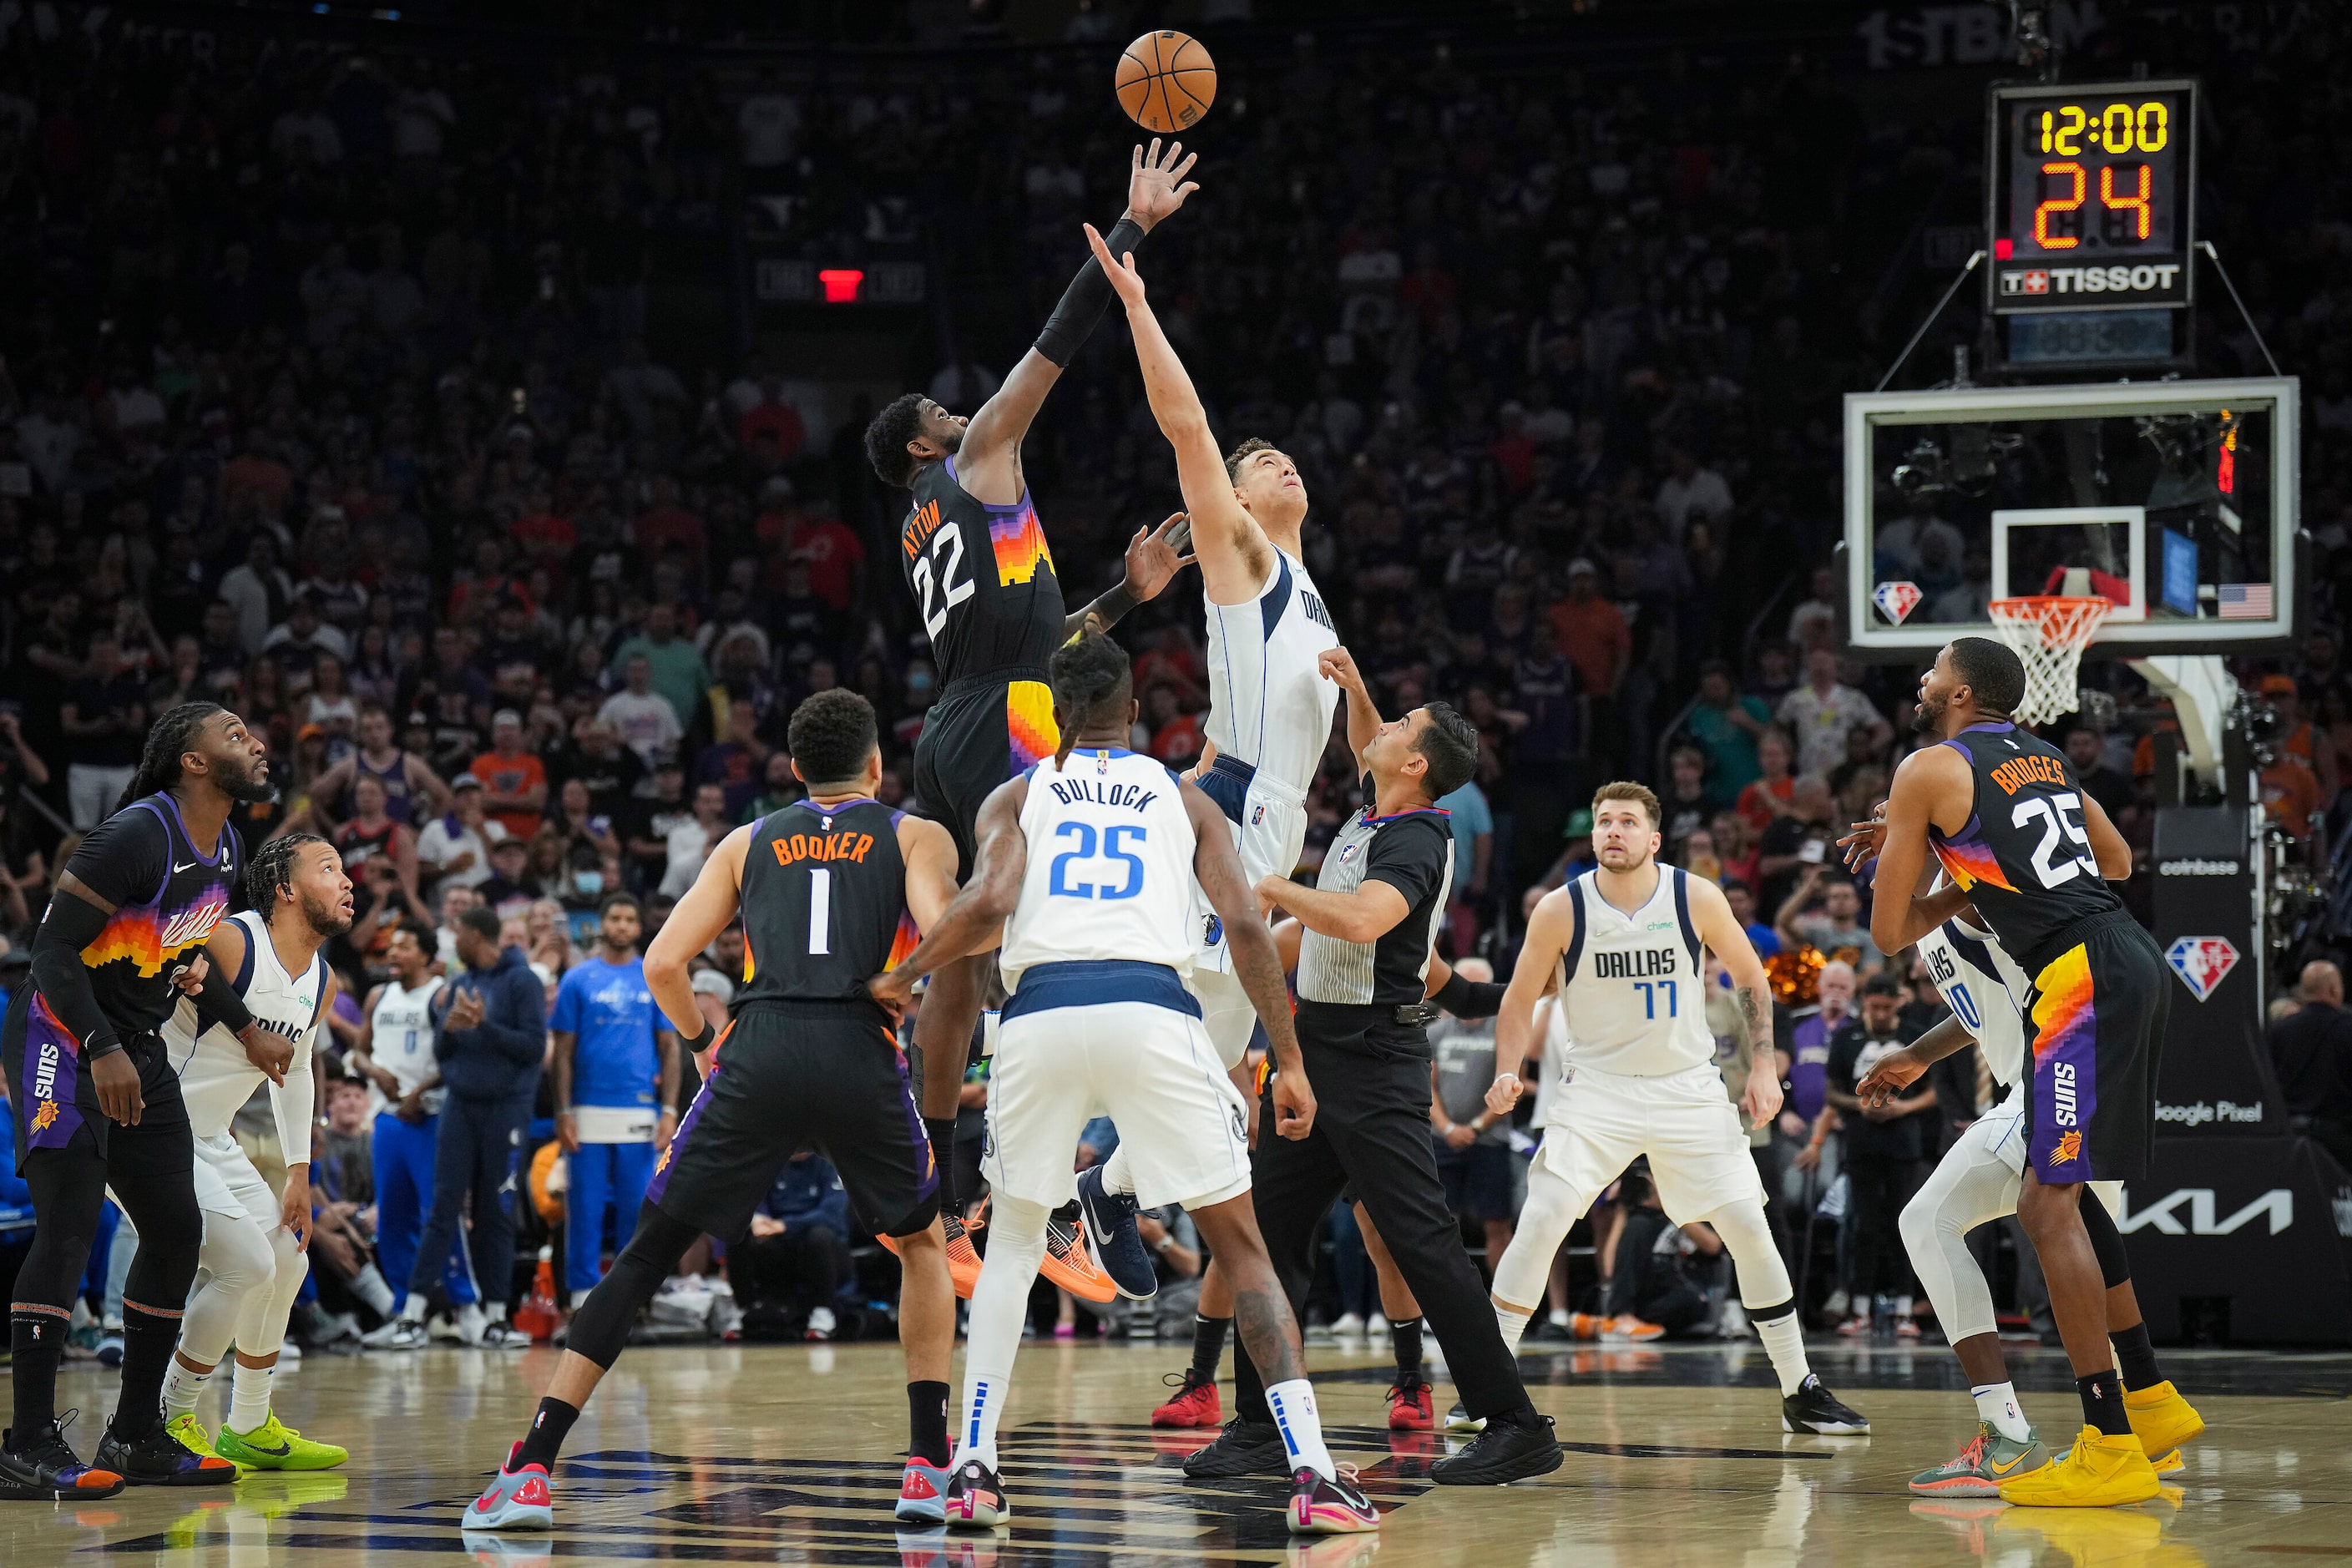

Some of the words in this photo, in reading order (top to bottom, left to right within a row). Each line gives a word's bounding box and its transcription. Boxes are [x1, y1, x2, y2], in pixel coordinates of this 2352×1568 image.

[1855, 2, 2105, 68] 1STBN
[2041, 102, 2167, 156] 12:00
[2035, 162, 2151, 249] 24
[2050, 265, 2180, 293] TISSOT
[903, 498, 941, 561] AYTON
[913, 522, 975, 643] 22
[1050, 779, 1158, 813] BULLOCK
[1990, 756, 2066, 796] BRIDGES
[771, 832, 874, 867] BOOKER
[1050, 822, 1146, 900] 25
[2011, 792, 2099, 889] 25
[2159, 858, 2238, 876] coinbase
[809, 867, 830, 954] 1
[1646, 921, 1673, 931] chime
[1595, 948, 1676, 979] DALLAS
[1634, 980, 1677, 1019] 77
[34, 1043, 59, 1099] SUNS
[2054, 1061, 2076, 1126] SUNS
[2216, 1100, 2263, 1122] Pixel
[2117, 1188, 2294, 1236] KIA
